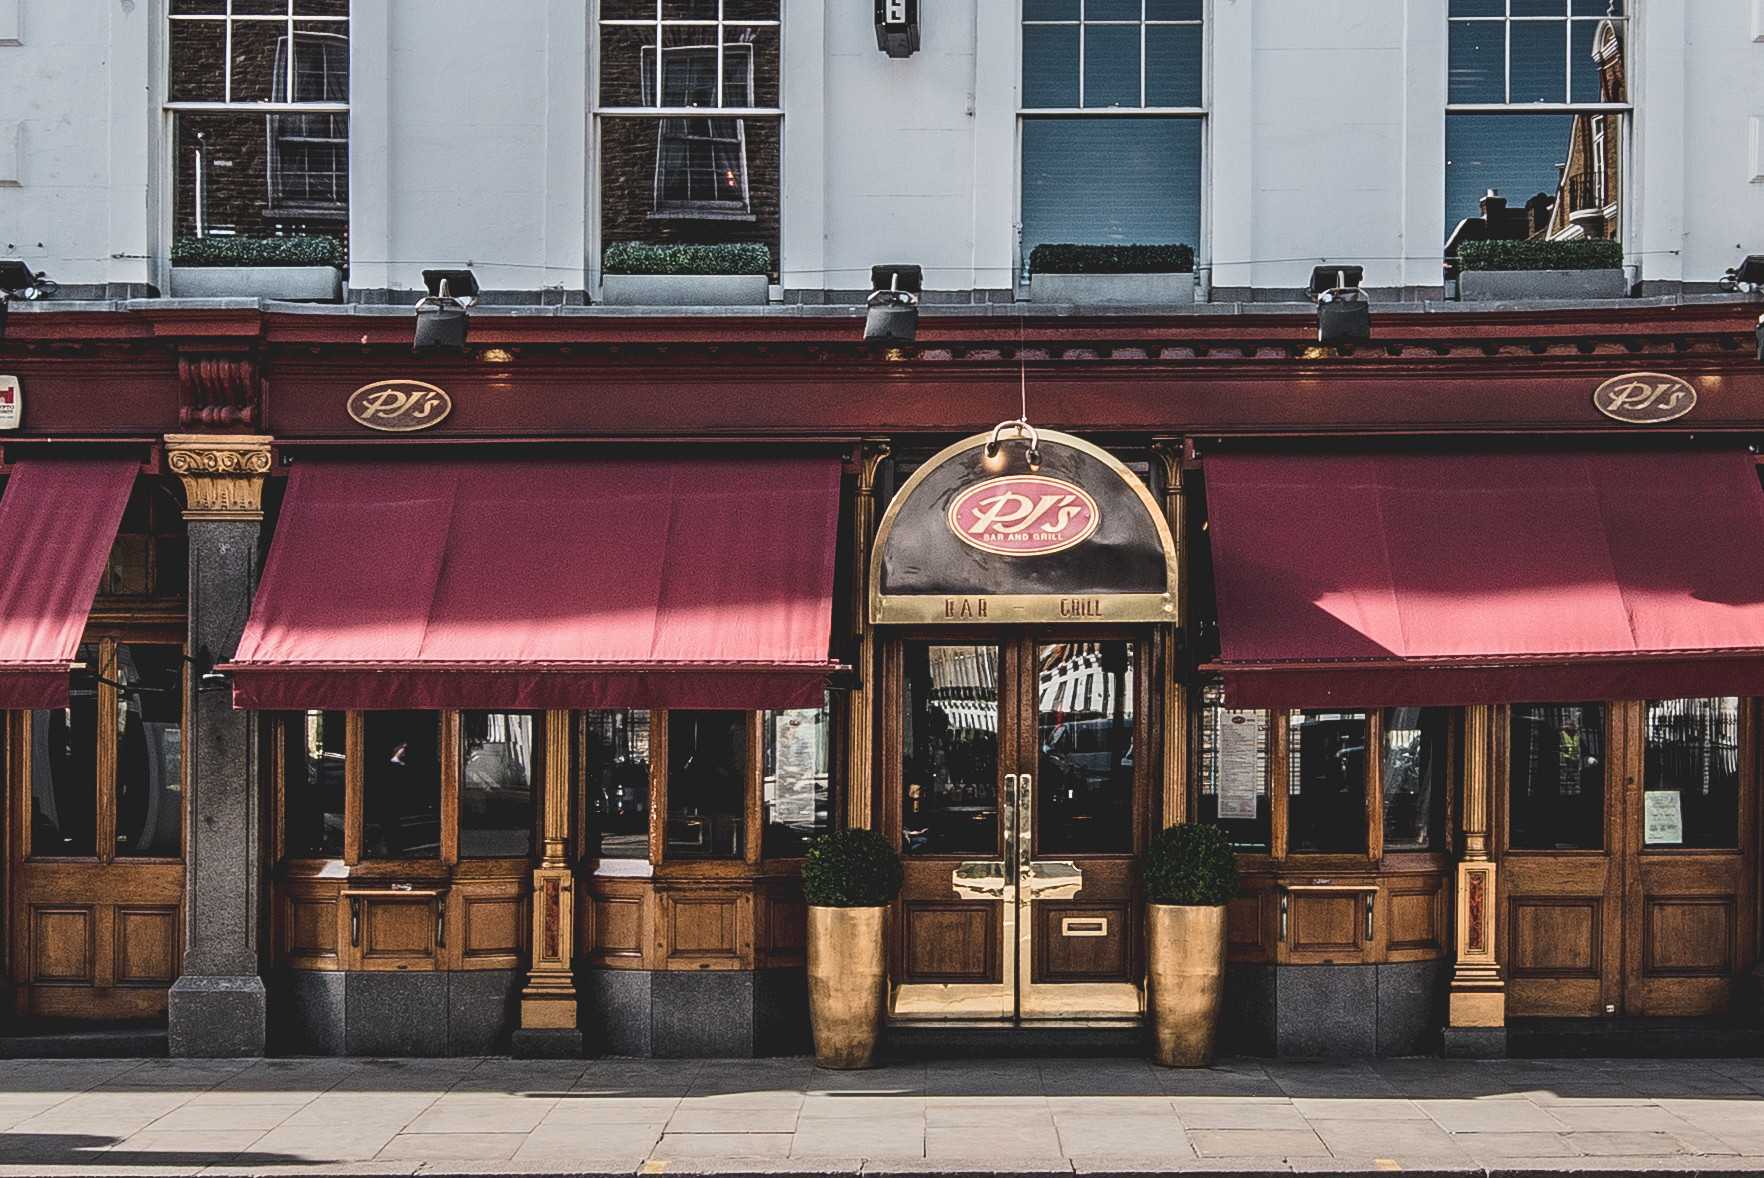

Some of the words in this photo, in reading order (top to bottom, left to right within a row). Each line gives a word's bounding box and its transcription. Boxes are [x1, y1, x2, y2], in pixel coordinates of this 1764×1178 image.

[360, 388, 440, 419] PJ's
[1607, 381, 1685, 410] PJ's
[968, 491, 1082, 534] PJ's
[983, 533, 1004, 541] BAR
[1008, 533, 1029, 541] AND
[1033, 532, 1064, 541] GRILL
[945, 599, 988, 617] BAR
[1060, 598, 1104, 616] GRILL
